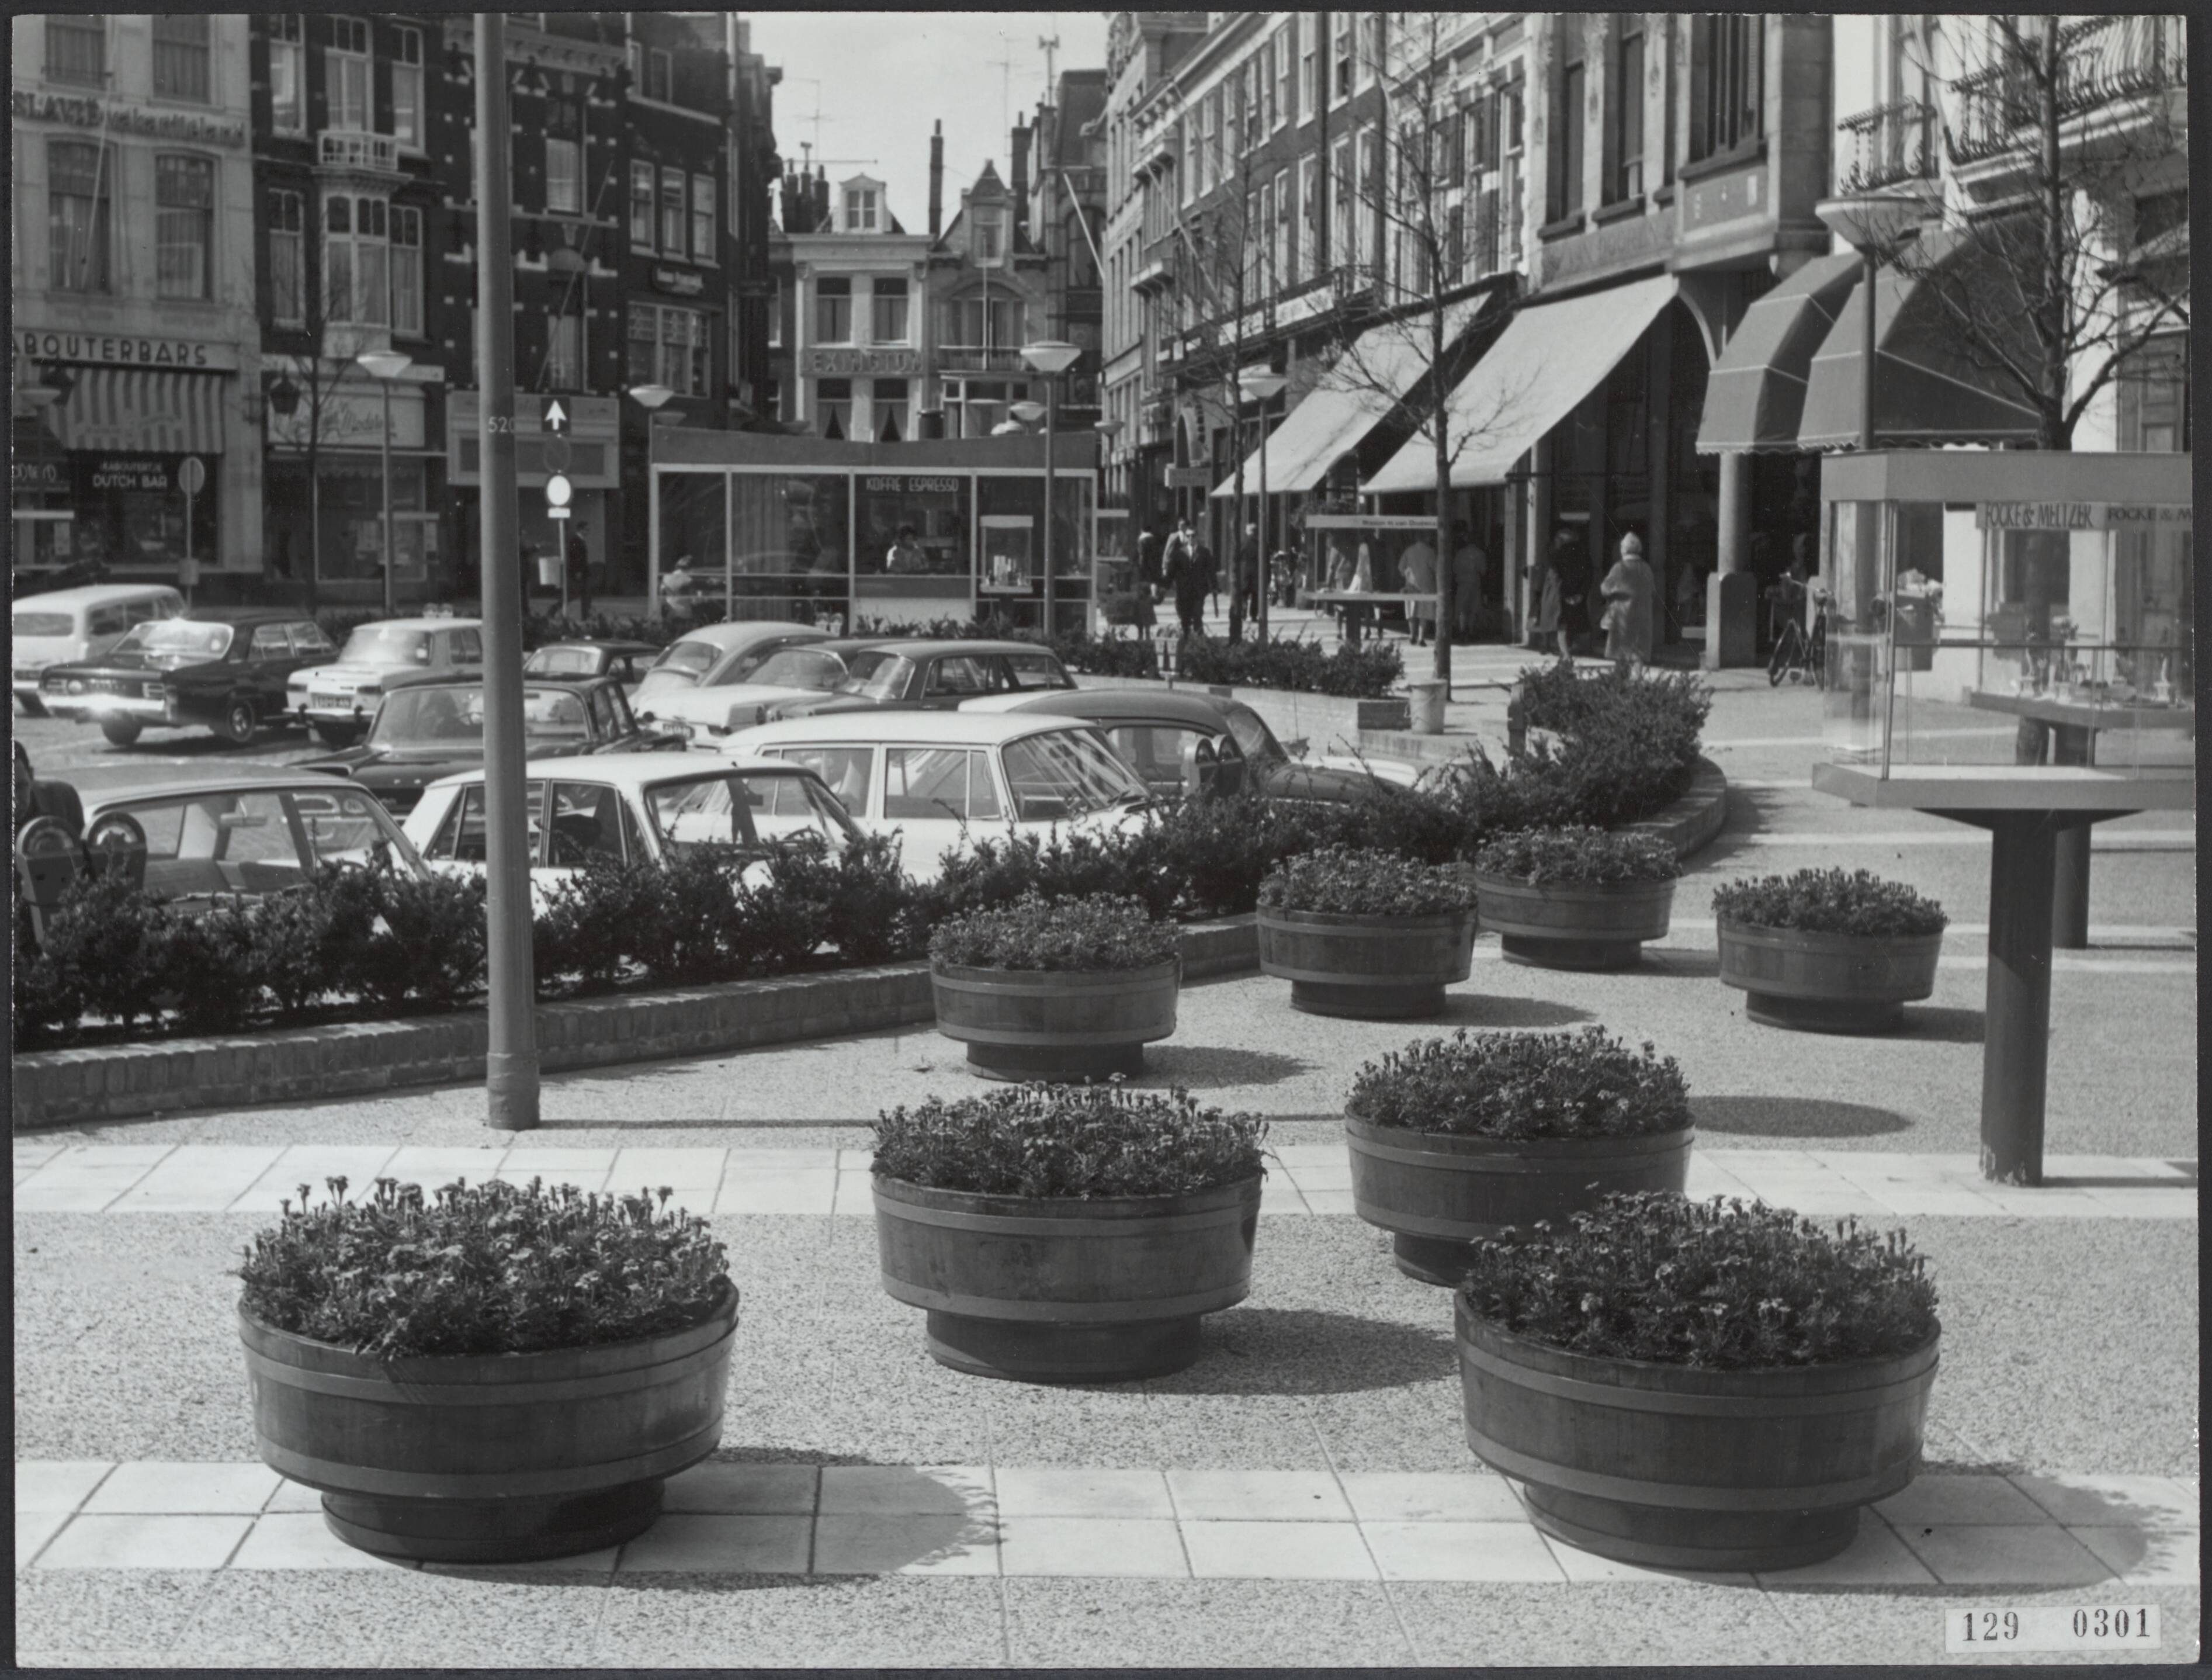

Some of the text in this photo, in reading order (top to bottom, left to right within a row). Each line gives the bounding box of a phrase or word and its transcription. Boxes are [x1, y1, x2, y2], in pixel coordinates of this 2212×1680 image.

[93, 474, 168, 488] DUTCH BAR
[909, 477, 959, 492] ESPRESSO
